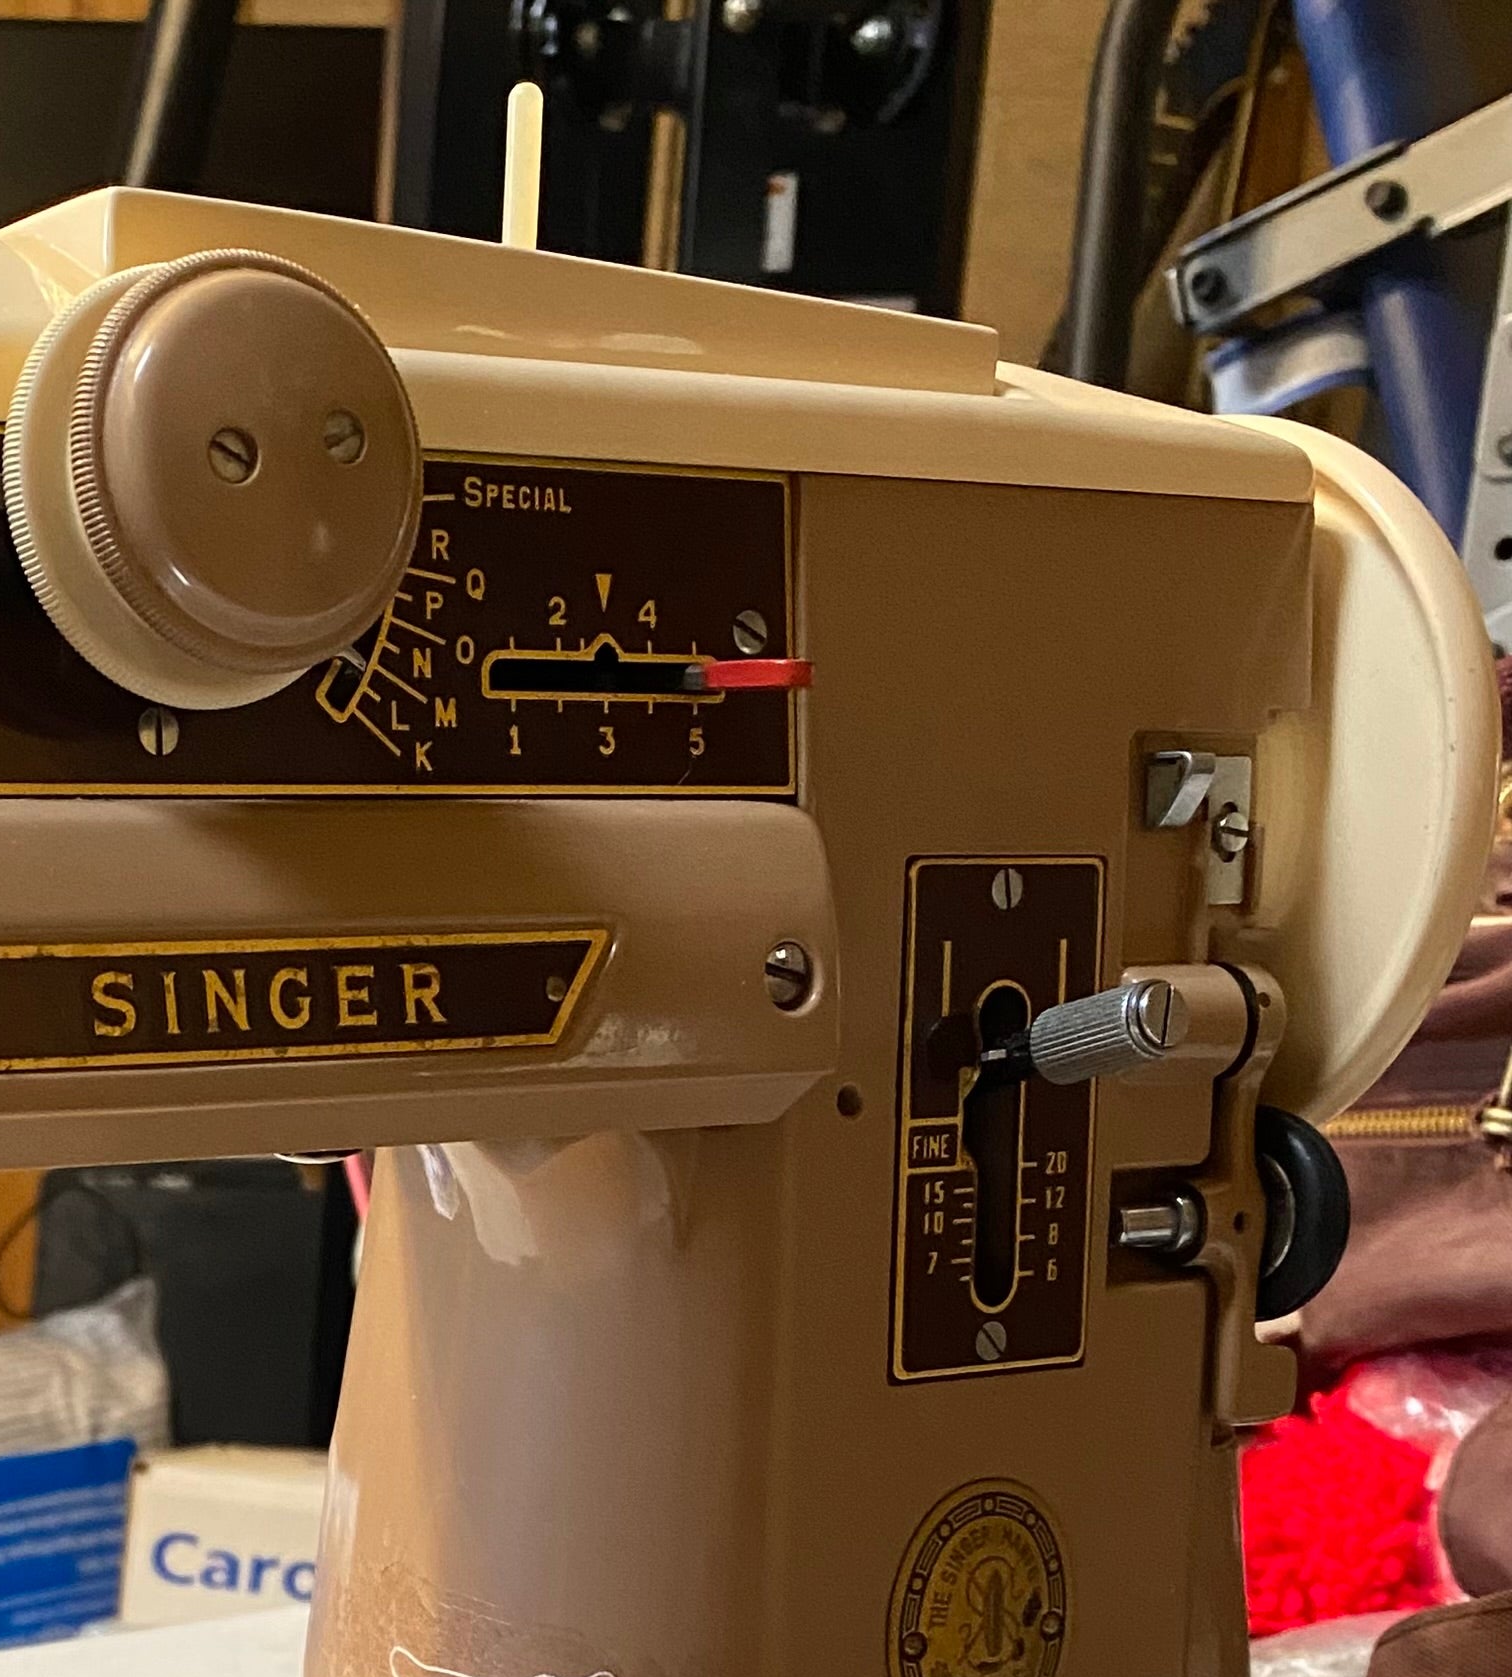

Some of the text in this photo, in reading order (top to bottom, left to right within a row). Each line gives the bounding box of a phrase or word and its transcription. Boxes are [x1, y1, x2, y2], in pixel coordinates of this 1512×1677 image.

[431, 529, 449, 560] R
[466, 568, 485, 600] Q
[426, 591, 444, 620] P
[548, 596, 657, 629] 2 4
[413, 648, 432, 679] N
[457, 635, 474, 664] O
[391, 700, 409, 731] L
[435, 697, 456, 728] M
[509, 725, 705, 757] 1 3 5
[416, 741, 434, 772] K
[91, 962, 448, 1038] SINGER
[912, 1134, 950, 1159] FINE
[1045, 1151, 1068, 1175] 20
[923, 1180, 945, 1205] 15
[1045, 1186, 1065, 1210] 12
[923, 1211, 944, 1235] 10
[1048, 1222, 1059, 1245] 8
[927, 1252, 938, 1275] 7
[1047, 1258, 1058, 1281] 6
